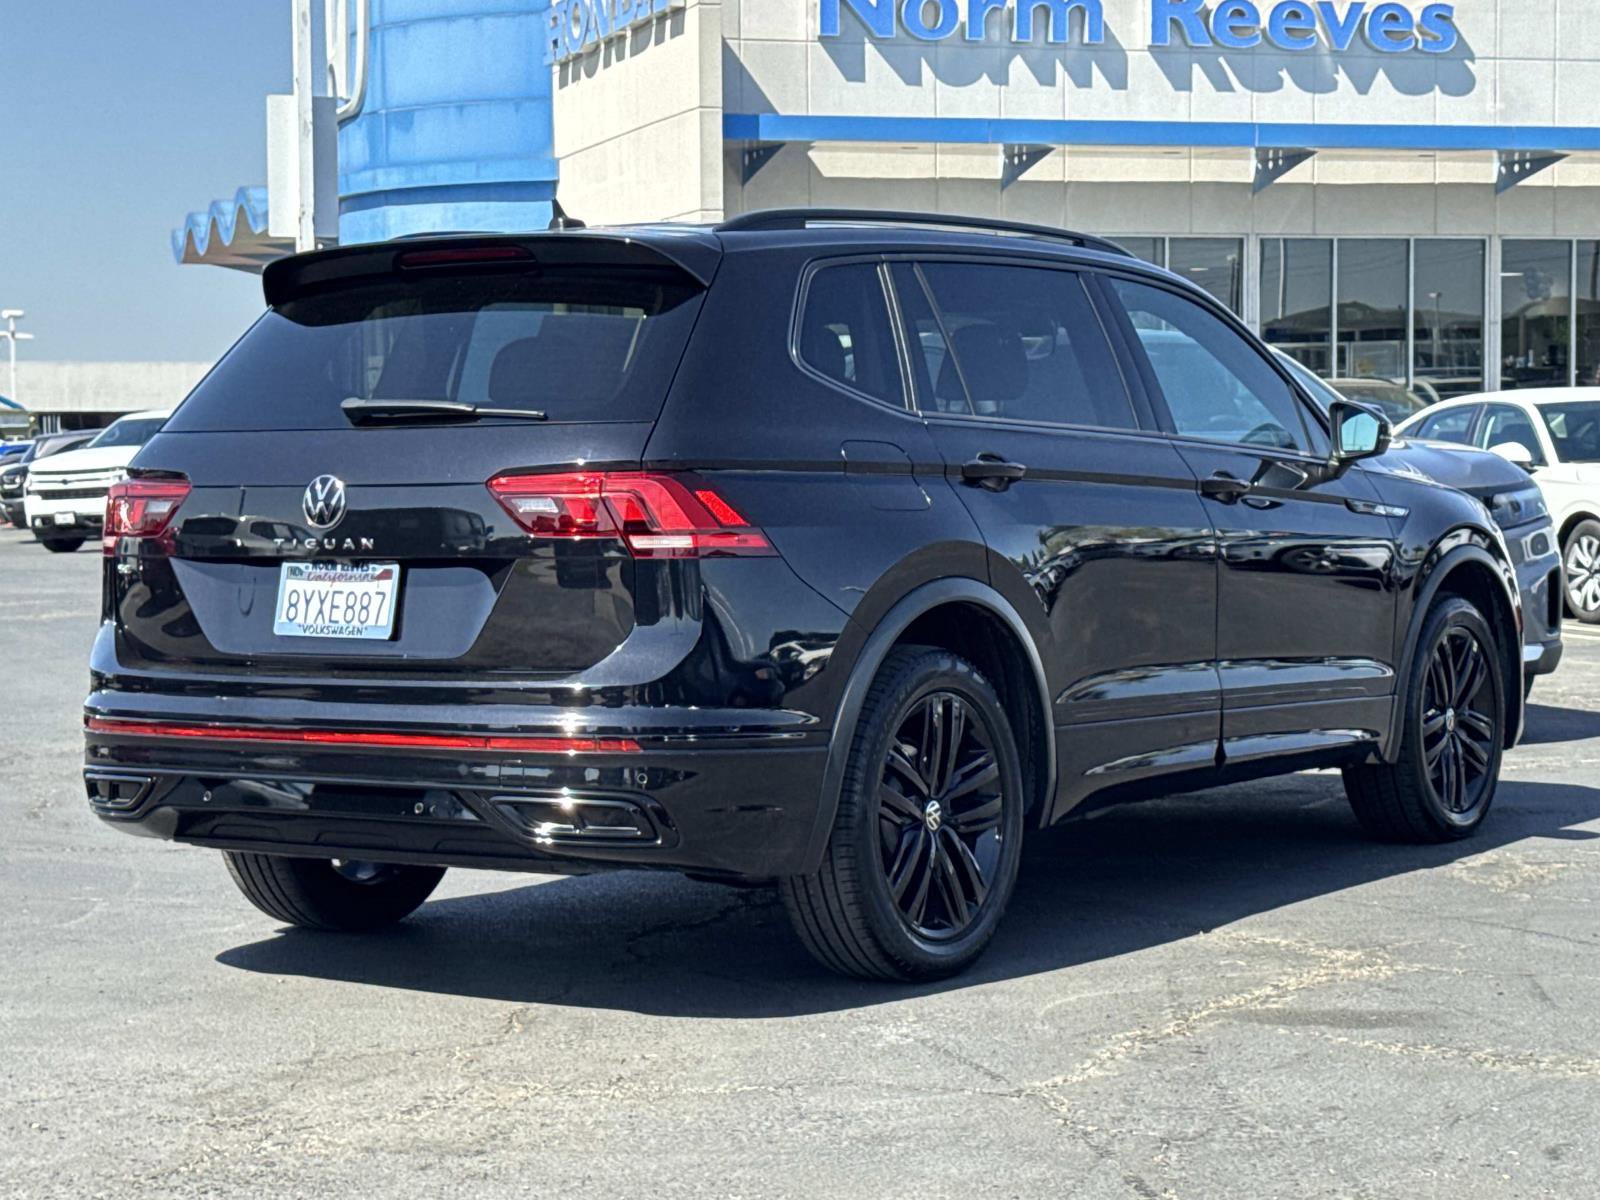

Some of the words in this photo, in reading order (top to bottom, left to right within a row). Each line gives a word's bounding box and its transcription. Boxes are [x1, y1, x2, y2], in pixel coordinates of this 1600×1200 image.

[819, 0, 1104, 44] Norm
[1150, 0, 1458, 52] Reeves
[273, 538, 375, 550] TIGUAN
[286, 589, 386, 625] 8YXE887
[302, 624, 363, 636] VOLKSWAGEN
